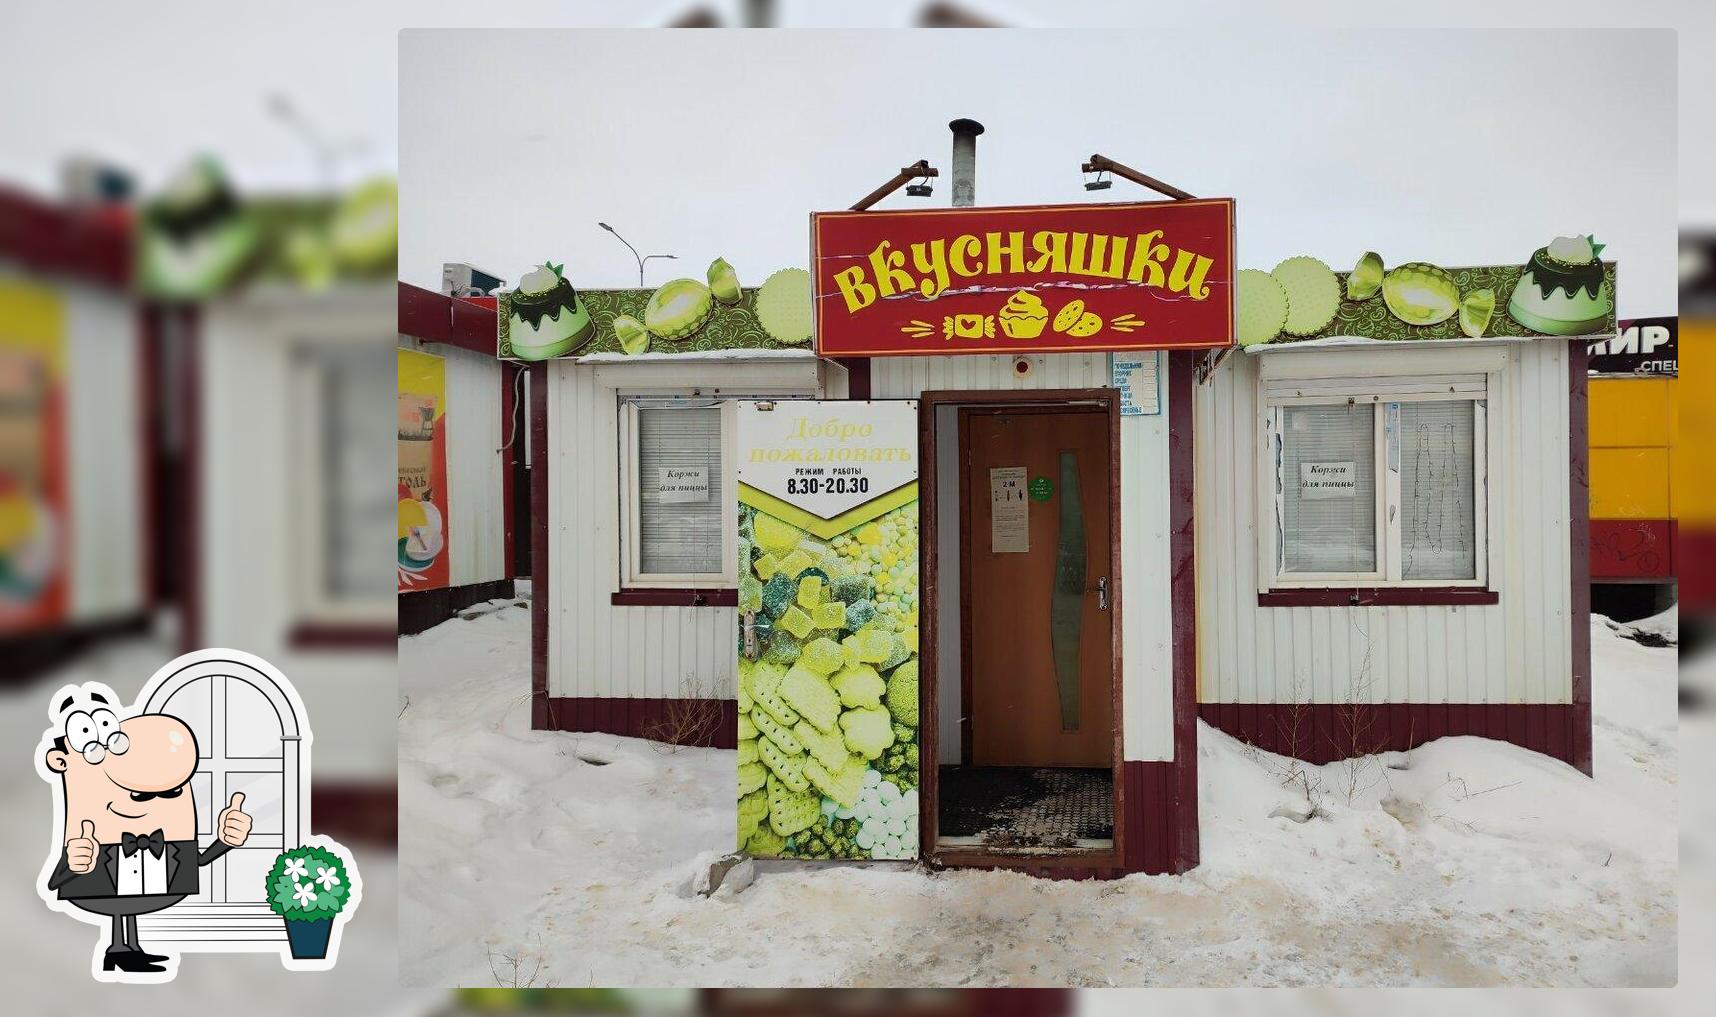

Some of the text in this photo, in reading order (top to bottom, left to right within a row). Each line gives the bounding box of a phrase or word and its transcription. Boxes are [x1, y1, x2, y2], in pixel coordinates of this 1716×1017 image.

[786, 415, 873, 442] Добро
[749, 447, 912, 465] пожаловать
[667, 470, 700, 480] Коржи
[795, 467, 862, 476] РЕЖИМ РАБОТЫ
[1310, 465, 1346, 476] Коржи
[787, 477, 869, 495] 8.30-20.30
